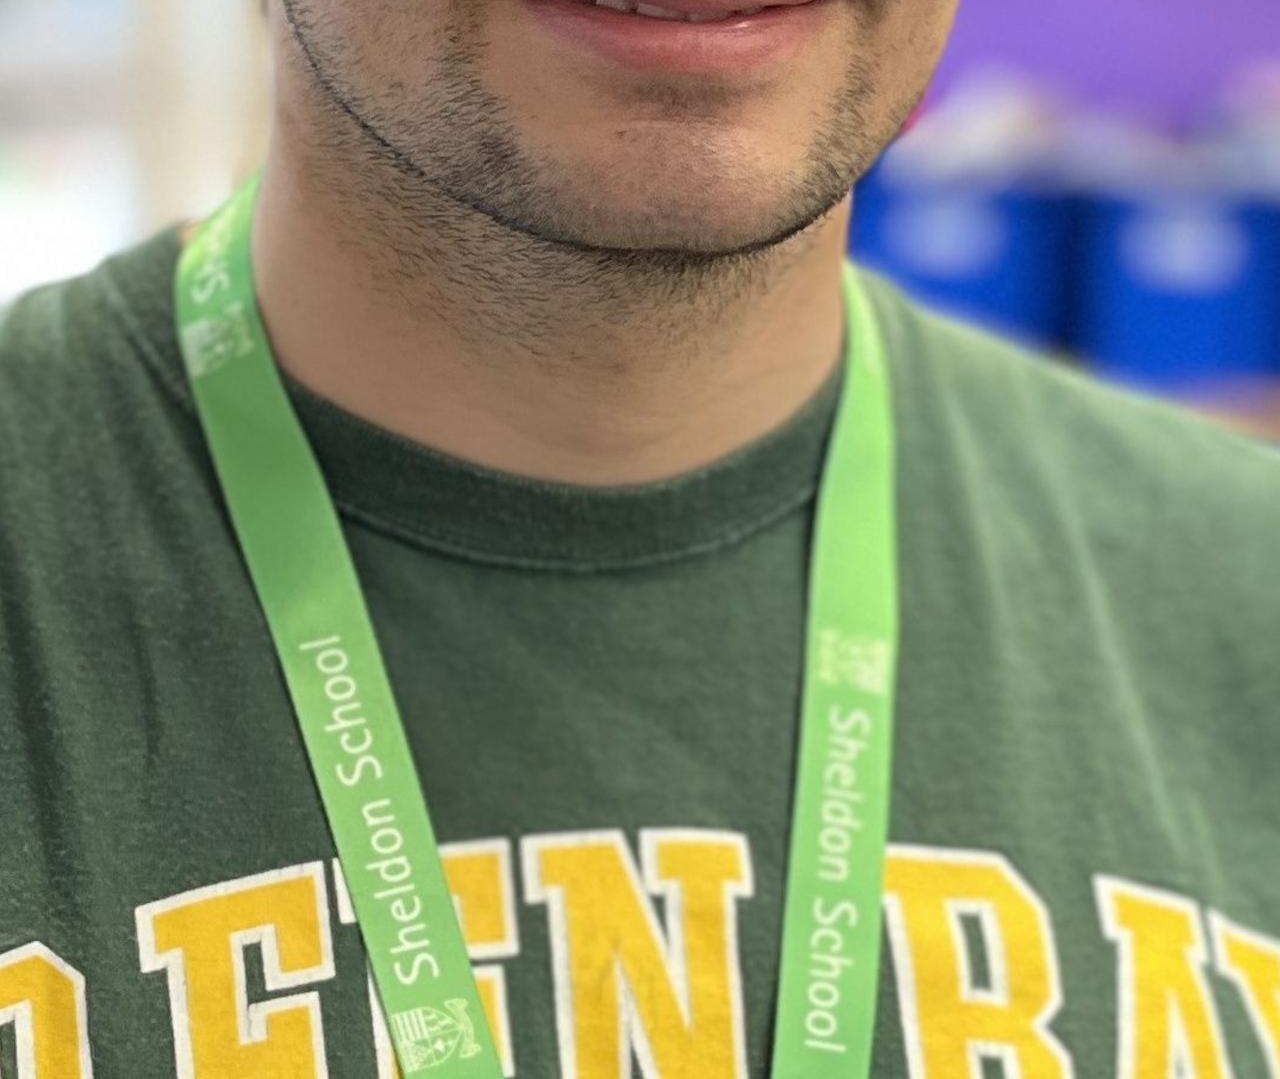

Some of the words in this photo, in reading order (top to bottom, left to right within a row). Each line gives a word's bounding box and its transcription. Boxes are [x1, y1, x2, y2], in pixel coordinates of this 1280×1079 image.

[298, 635, 383, 787] School
[817, 704, 872, 883] Sheldon
[364, 798, 440, 985] Sheldon
[803, 896, 859, 1053] School
